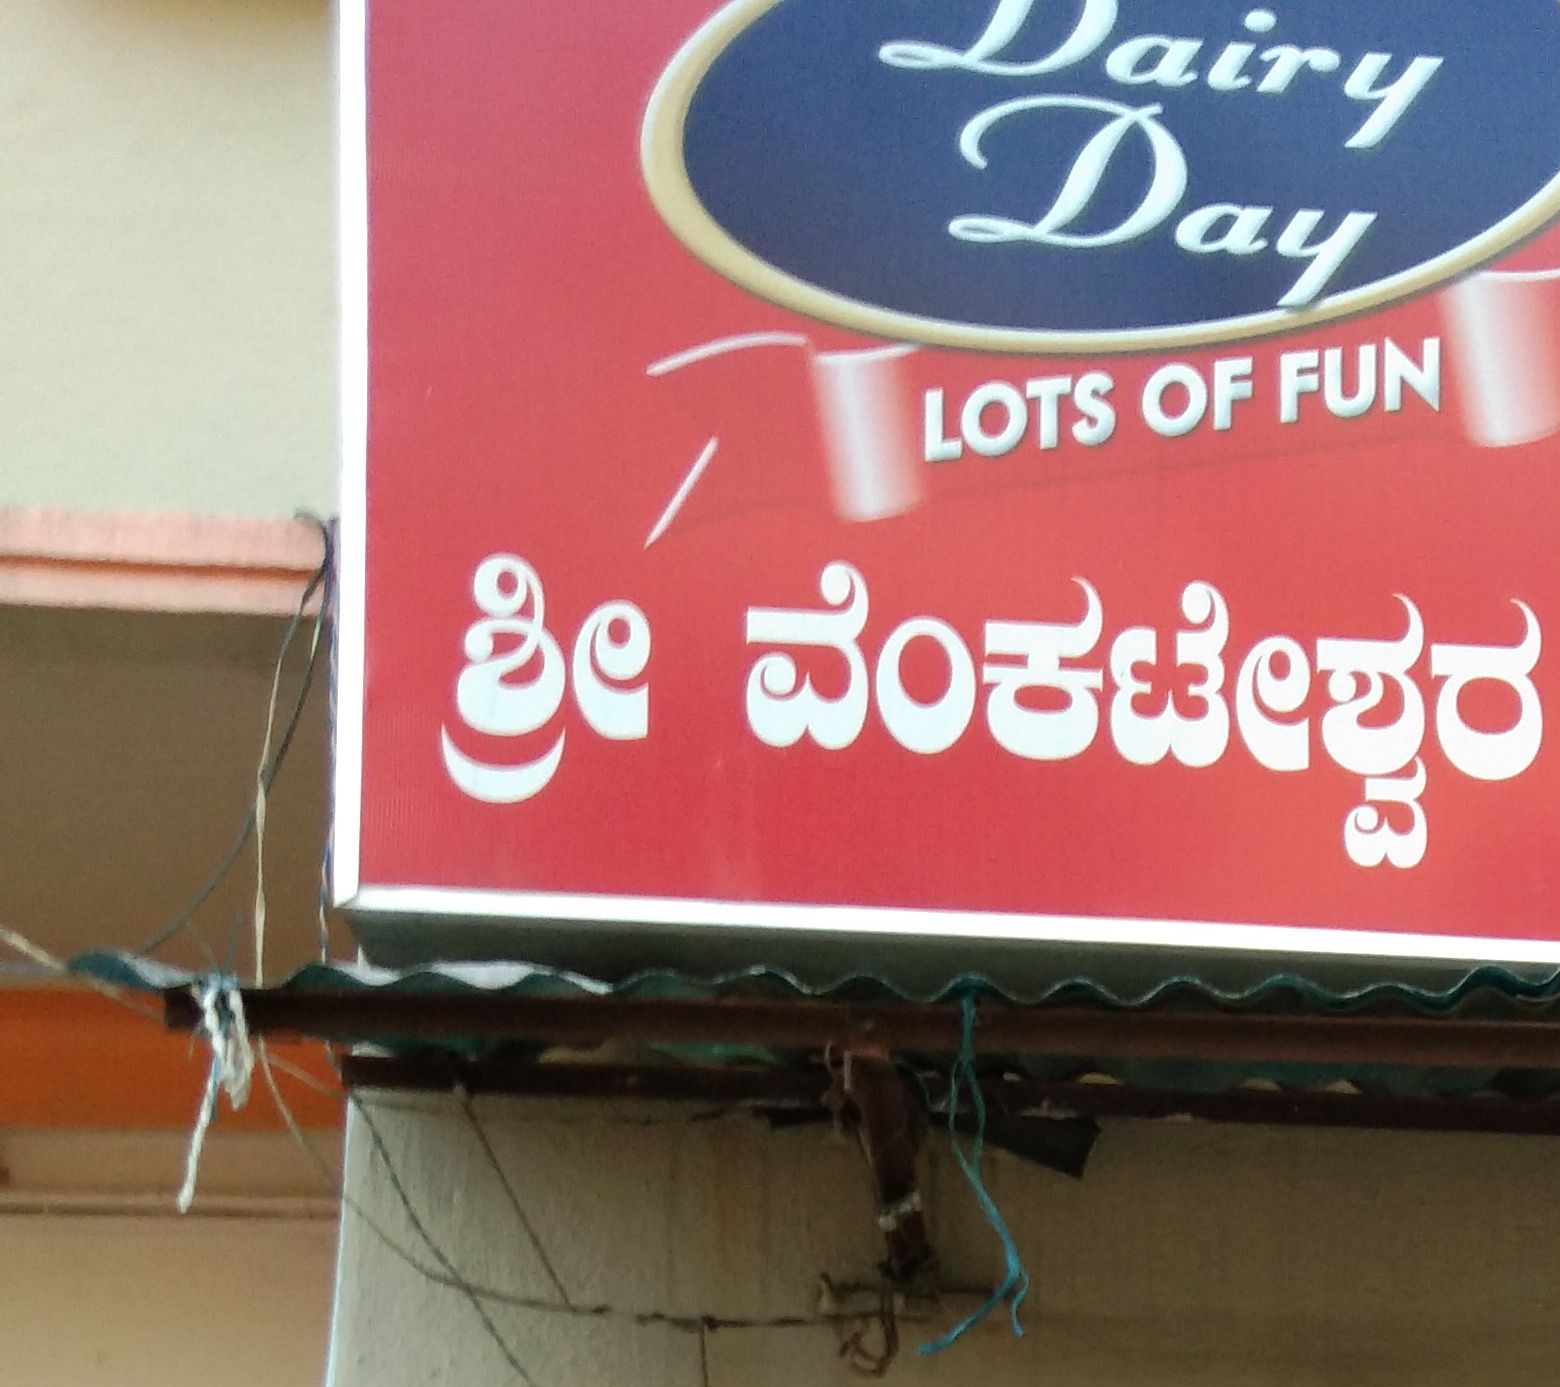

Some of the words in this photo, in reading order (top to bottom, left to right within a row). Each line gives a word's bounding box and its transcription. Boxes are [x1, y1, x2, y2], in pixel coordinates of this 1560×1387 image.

[878, 0, 1443, 148] Dairy
[948, 94, 1378, 308] Day
[923, 373, 1117, 462] LOTS
[1141, 355, 1255, 432] OF
[1279, 338, 1441, 425] FUN
[440, 553, 652, 805] ಶ್ರೀ
